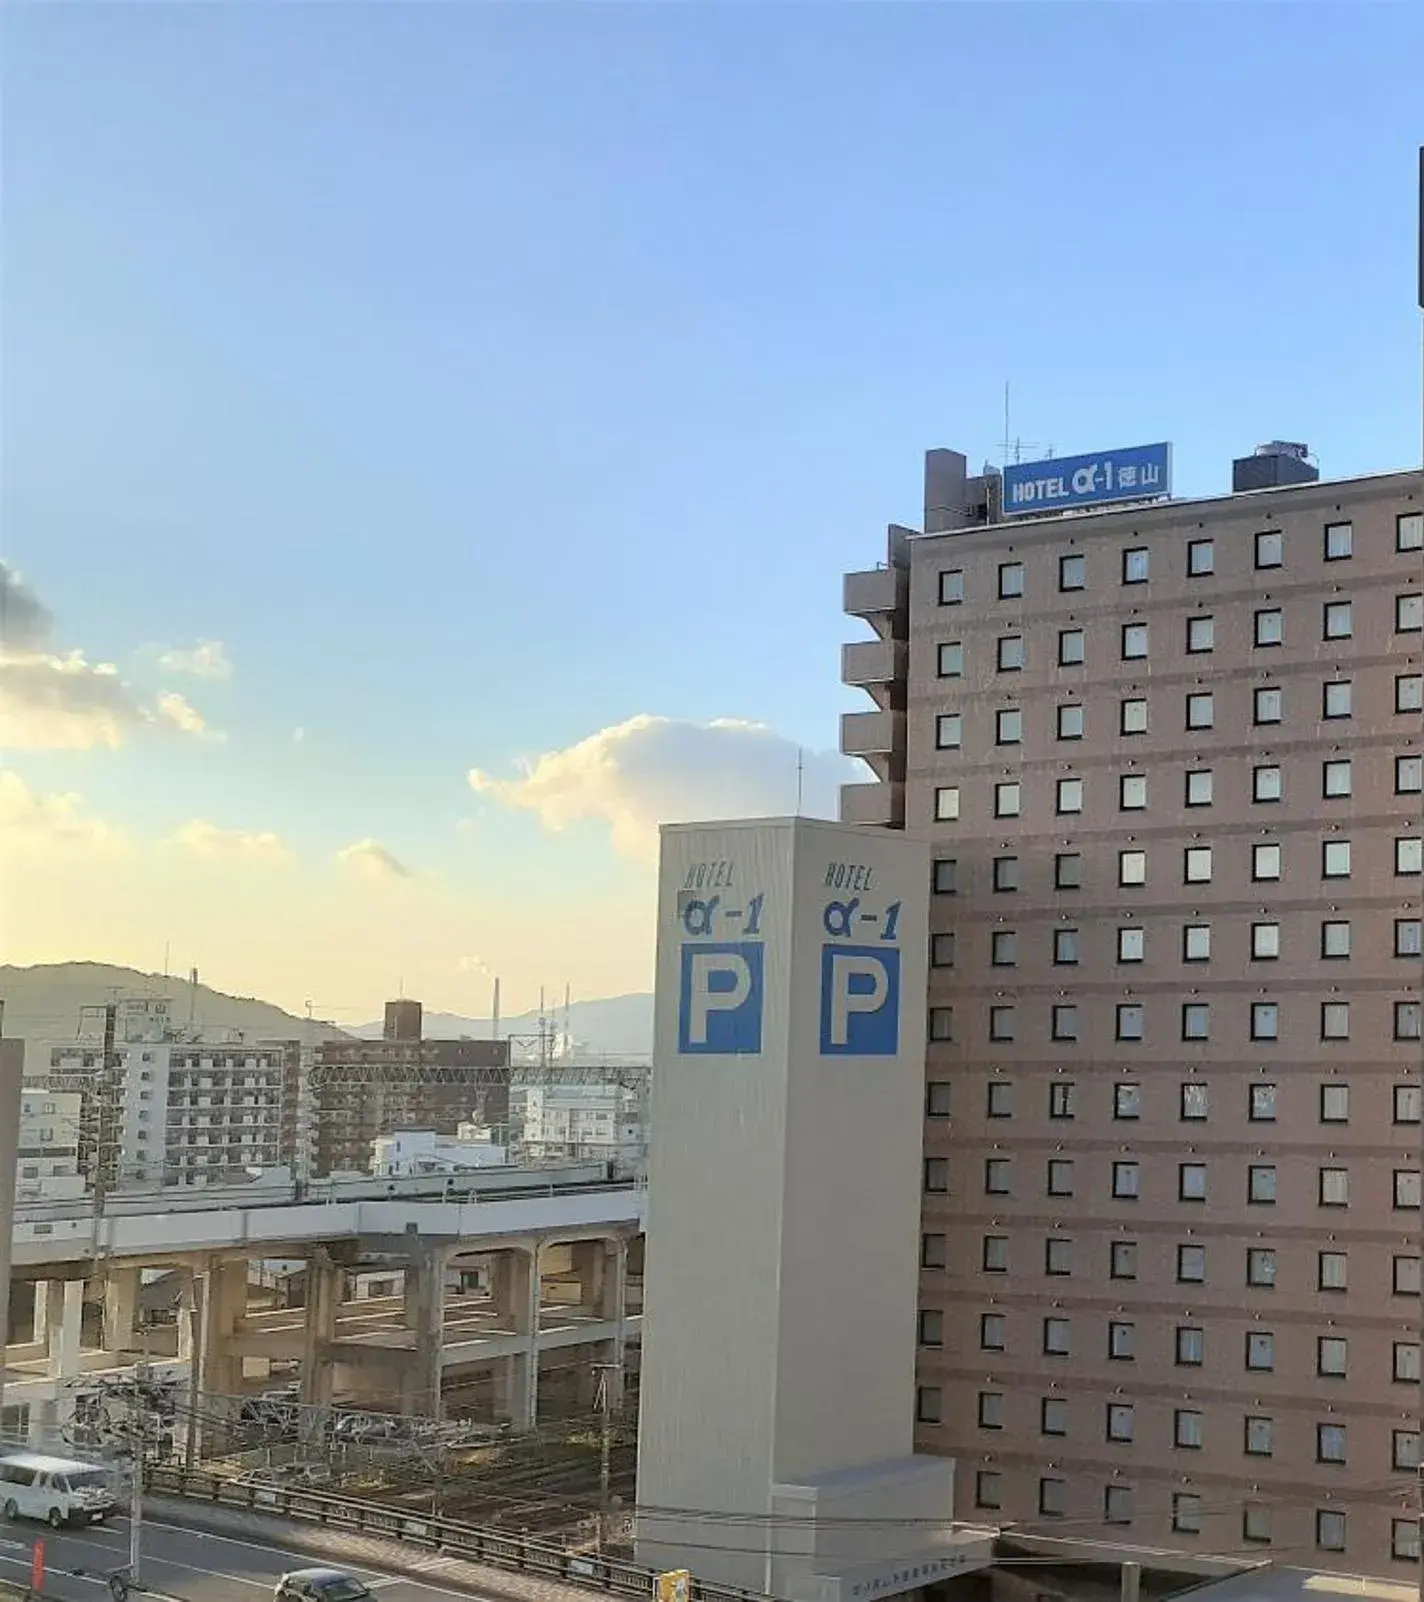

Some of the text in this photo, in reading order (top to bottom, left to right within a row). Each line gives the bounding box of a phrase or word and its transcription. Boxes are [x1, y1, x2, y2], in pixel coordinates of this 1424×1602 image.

[1012, 478, 1069, 503] HOTEL
[684, 861, 734, 888] HOTEL
[824, 862, 873, 891] HOTEL
[689, 953, 751, 1043] P
[831, 954, 888, 1044] P
